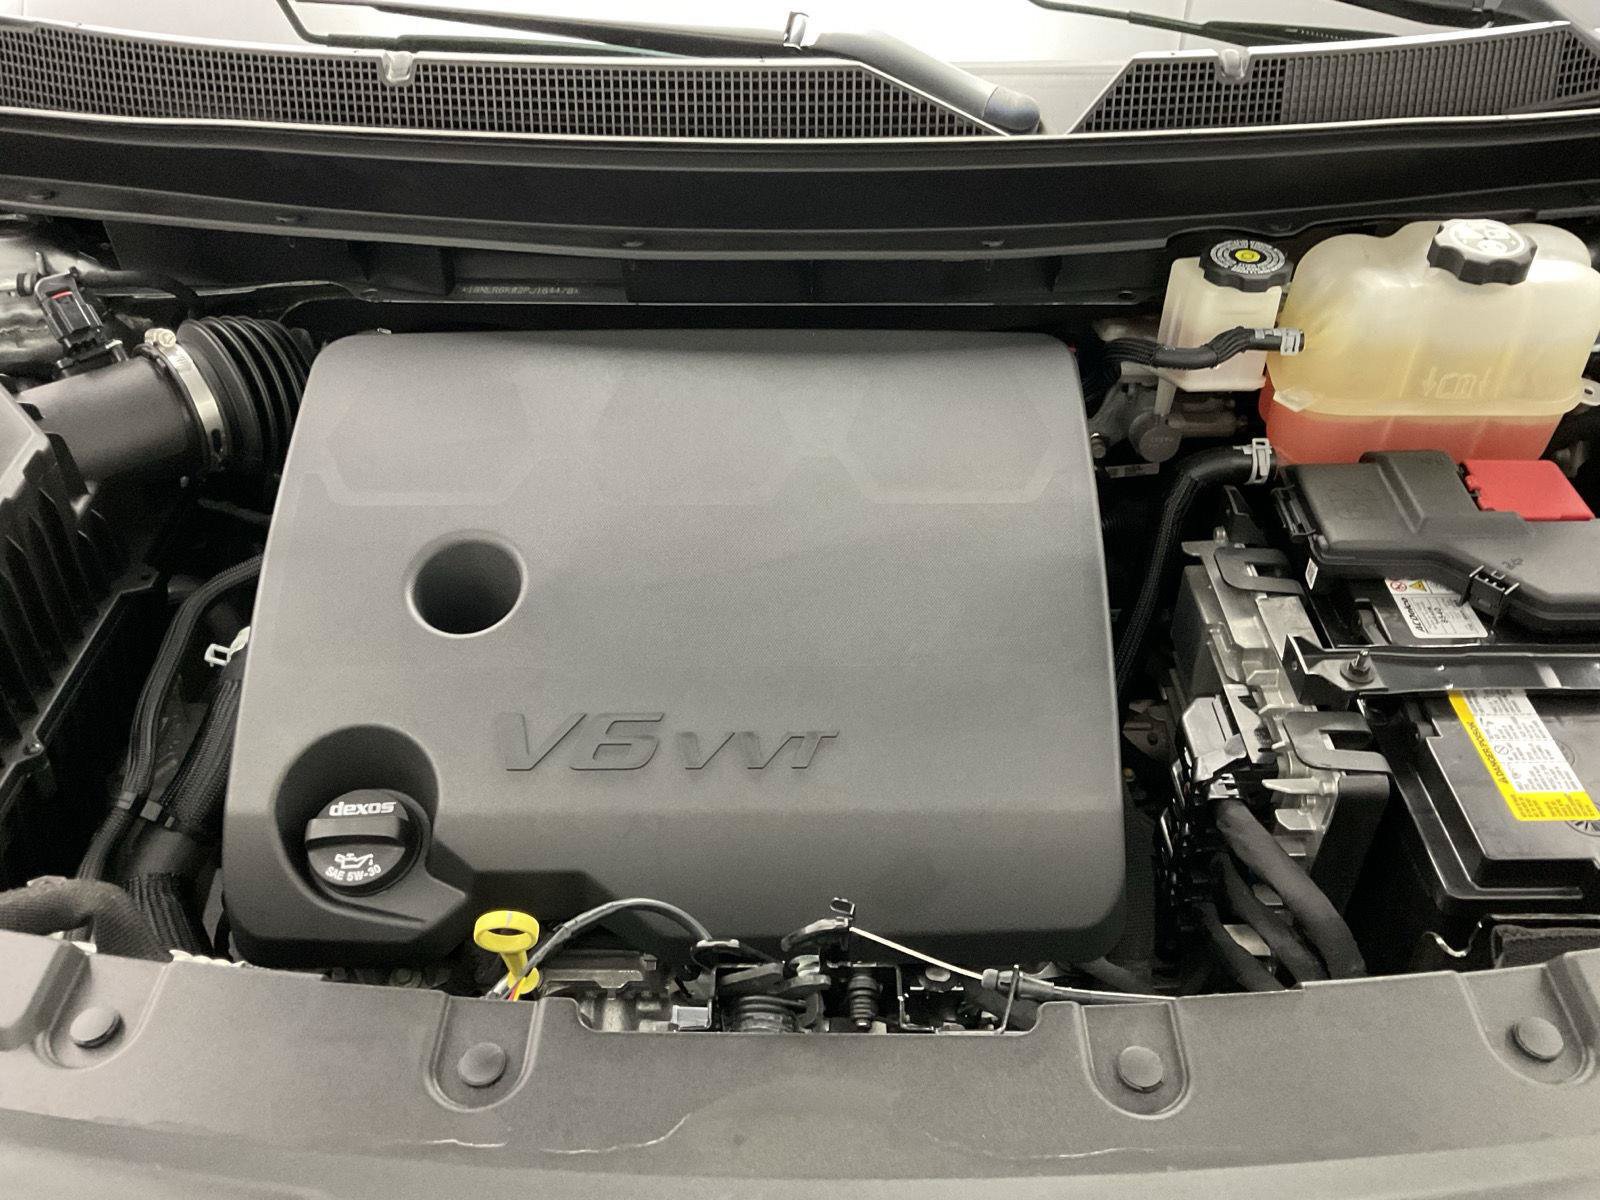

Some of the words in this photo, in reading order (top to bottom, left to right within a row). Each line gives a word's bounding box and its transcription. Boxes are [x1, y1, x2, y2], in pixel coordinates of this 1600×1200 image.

[497, 713, 664, 771] V6
[677, 731, 840, 770] VVT
[1466, 720, 1486, 749] POISON
[1482, 747, 1504, 778] DANGER
[329, 801, 396, 816] dexos
[325, 866, 345, 880] SAE
[346, 864, 381, 881] 5W-30
